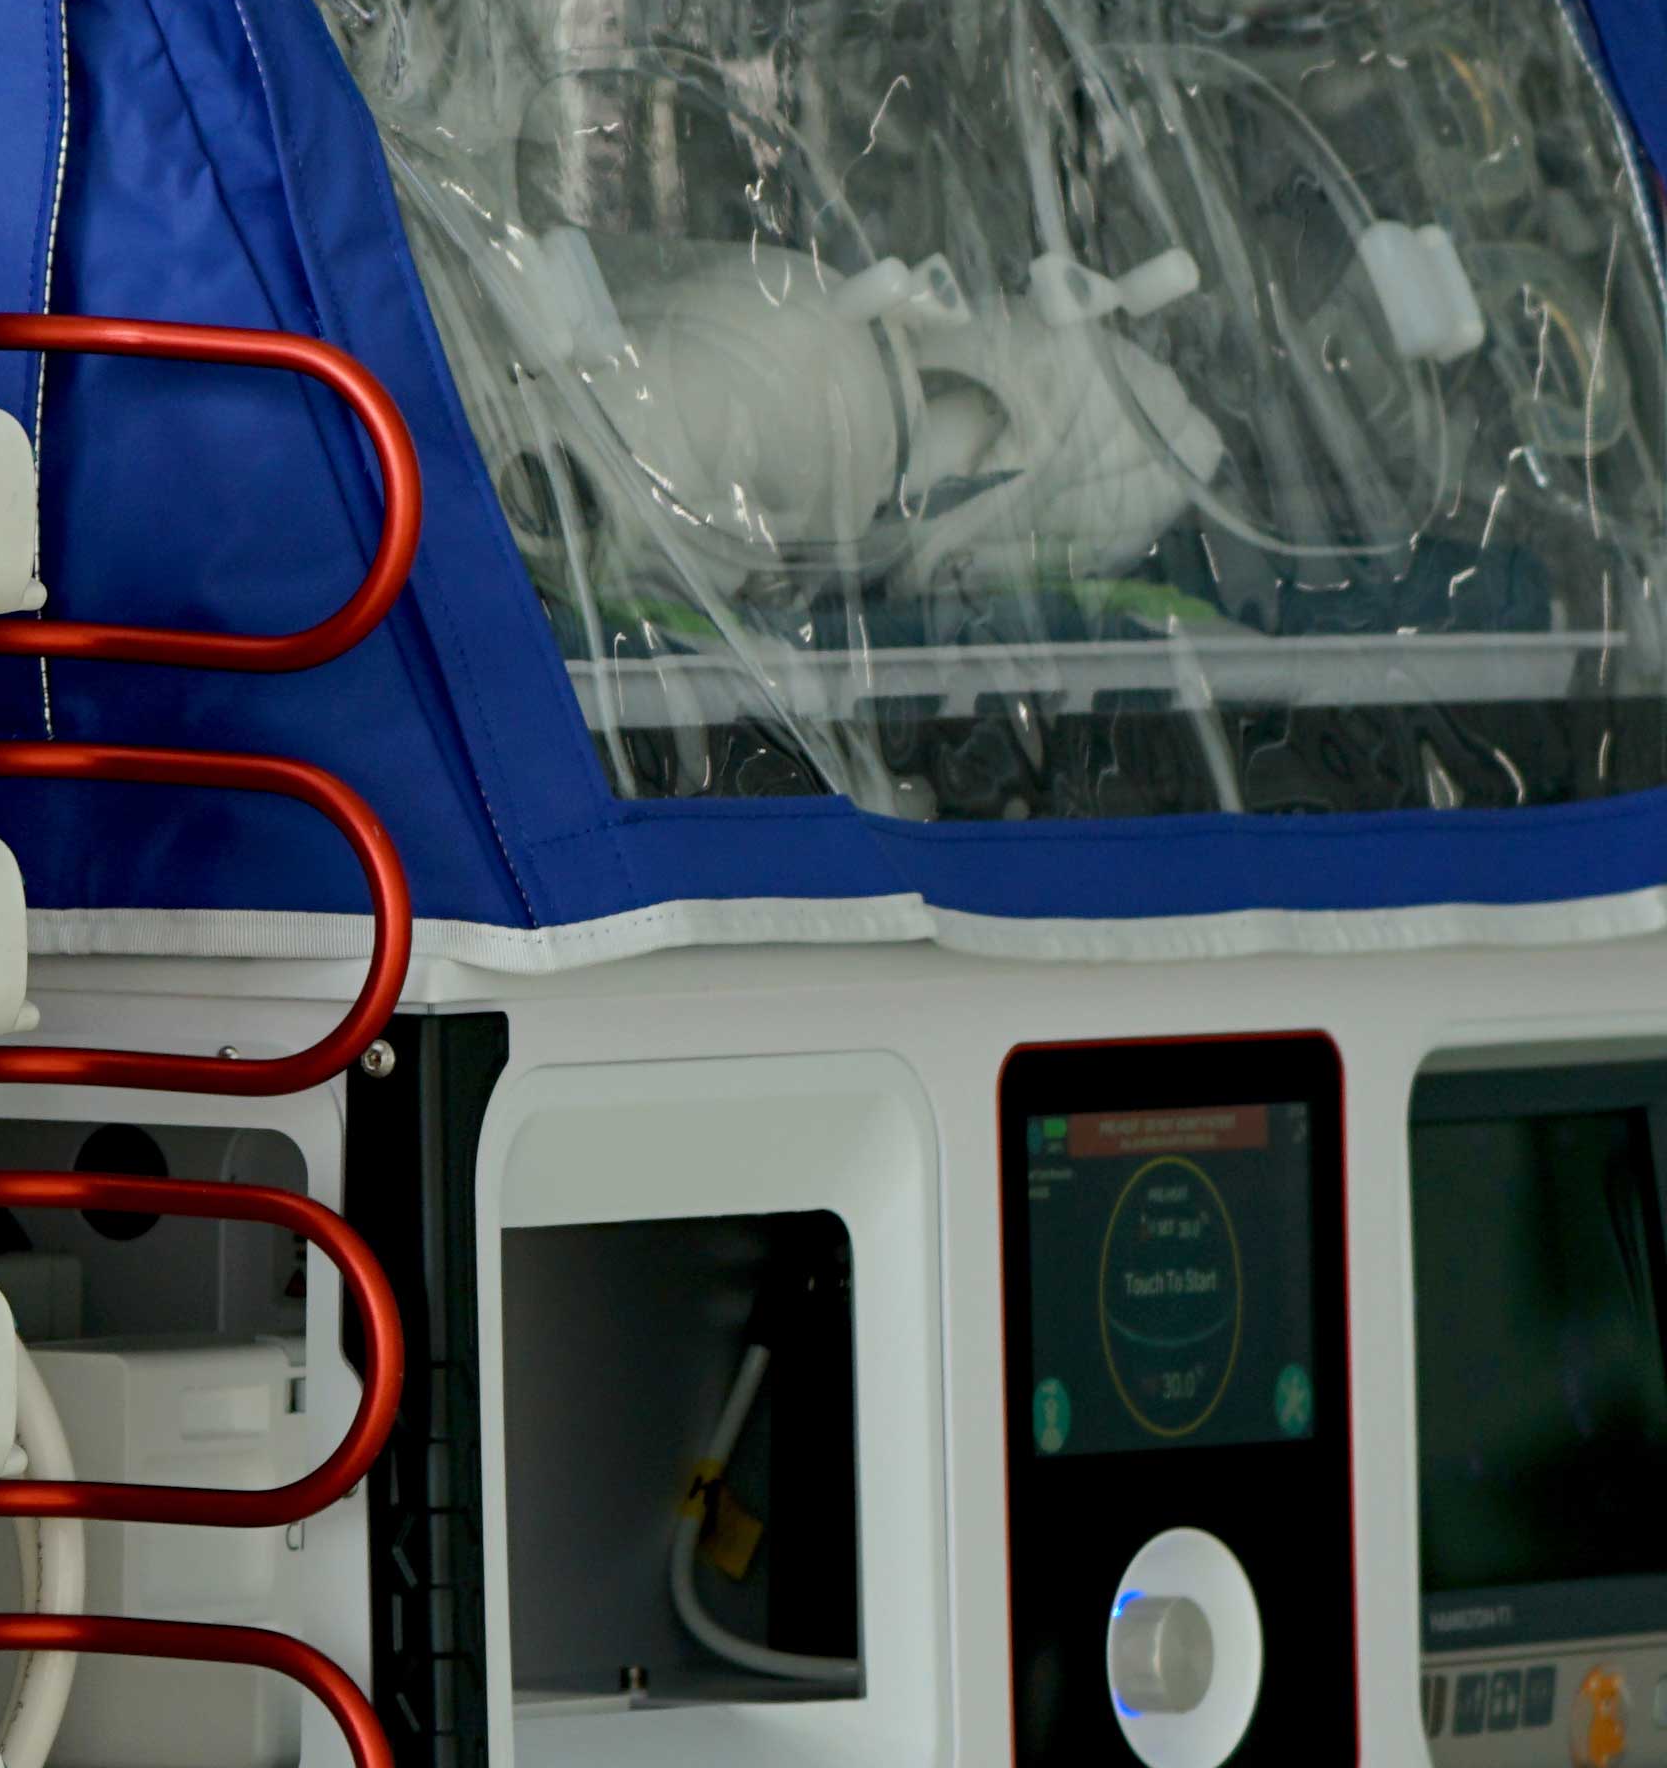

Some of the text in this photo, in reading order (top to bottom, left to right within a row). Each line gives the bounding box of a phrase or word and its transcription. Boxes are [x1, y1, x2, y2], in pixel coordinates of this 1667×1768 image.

[1124, 1267, 1217, 1297] Touch To Start
